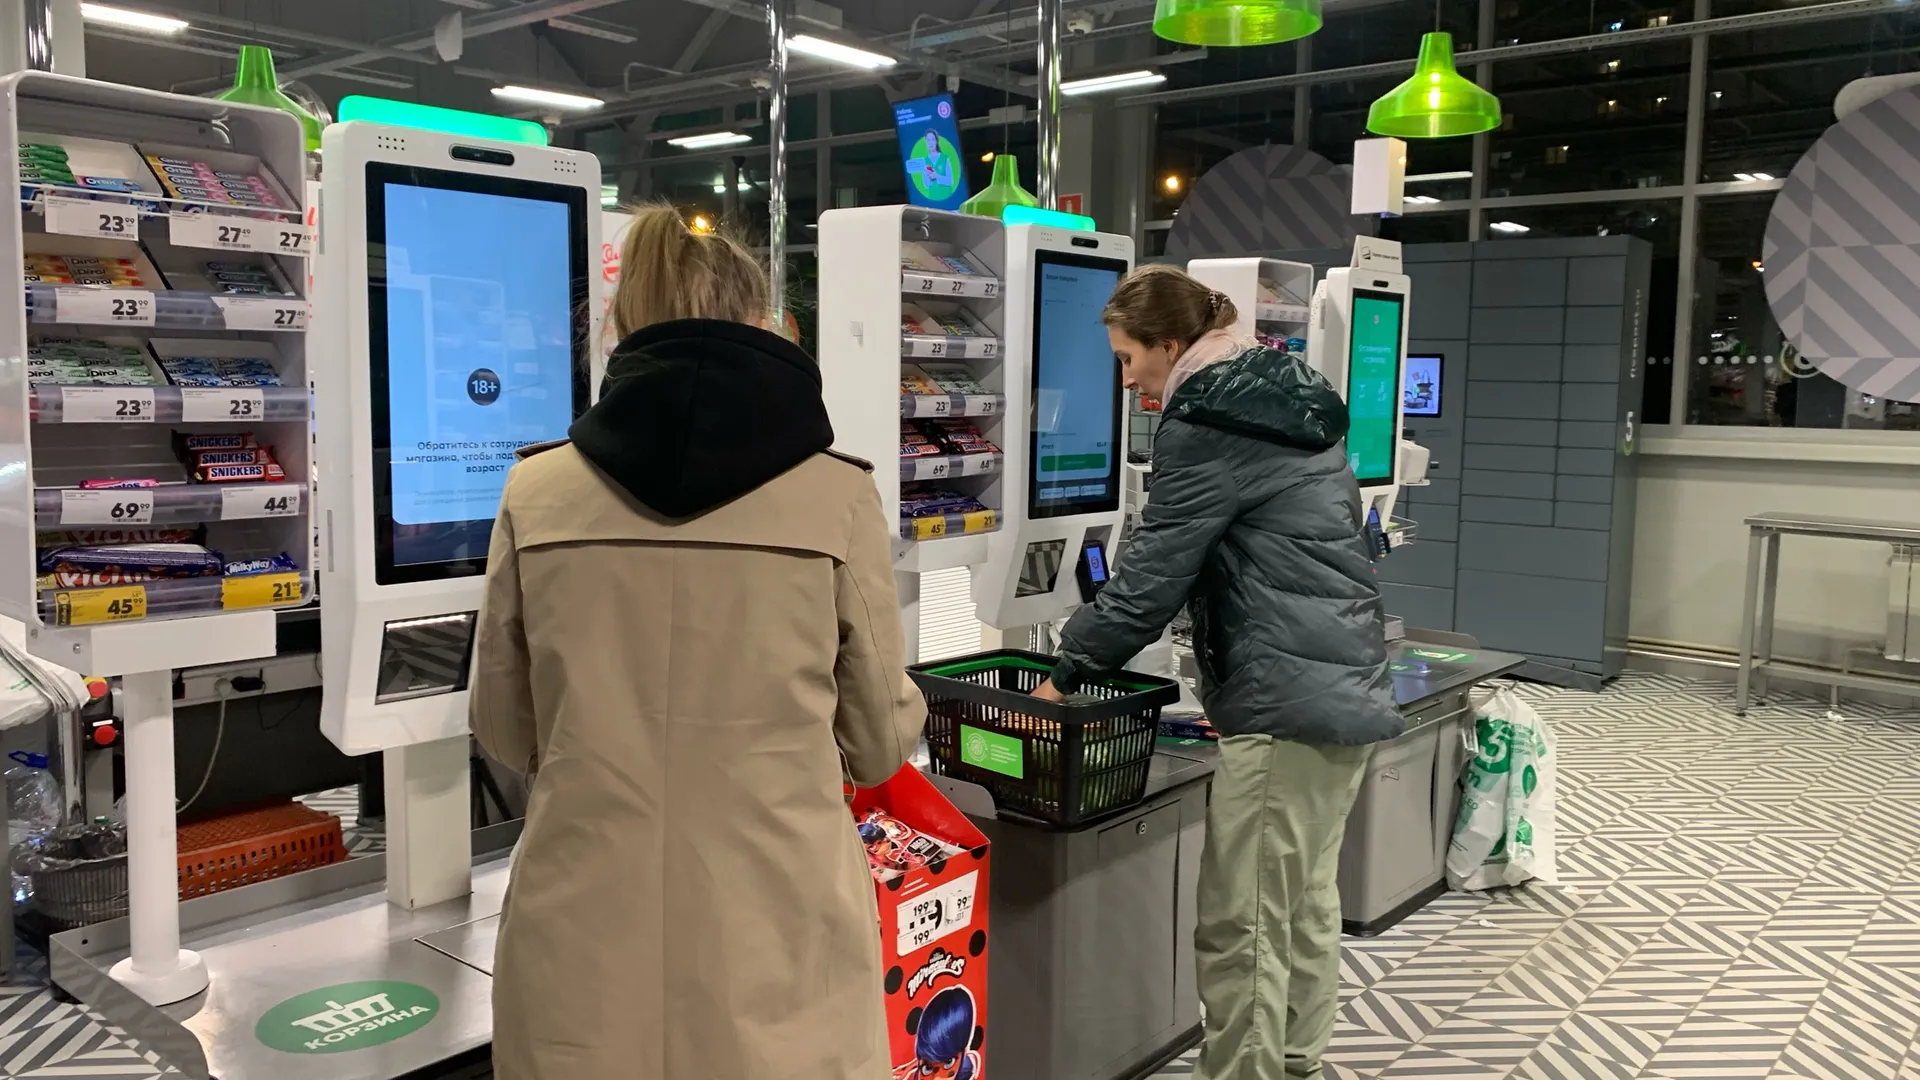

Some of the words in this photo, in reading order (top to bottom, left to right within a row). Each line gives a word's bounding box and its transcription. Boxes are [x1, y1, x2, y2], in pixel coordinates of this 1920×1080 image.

[164, 165, 194, 175] Orbit
[170, 176, 200, 186] Orbit
[177, 186, 208, 196] Orbit
[99, 214, 125, 232] 23
[218, 226, 241, 243] 27
[280, 231, 302, 248] 27
[922, 279, 933, 290] 23
[951, 281, 962, 291] 27
[984, 283, 994, 293] 27
[112, 299, 138, 316] 23
[274, 309, 297, 325] 27
[931, 343, 942, 353] 23
[983, 344, 993, 353] 27
[91, 369, 118, 377] Dirol
[471, 379, 498, 394] 18+
[116, 400, 141, 416] 23
[229, 399, 252, 415] 23
[936, 401, 946, 411] 23
[982, 402, 992, 411] 23
[188, 436, 241, 448] SNICKERS
[417, 440, 479, 451] Обратитесь
[202, 452, 253, 464] SNICKERS
[406, 454, 460, 463] магазина,
[462, 452, 493, 461] чтобы
[211, 466, 262, 478] SNICKERS
[466, 464, 505, 473] возраст
[933, 465, 944, 475] 69
[111, 502, 139, 518] 69
[264, 497, 287, 512] 44
[984, 516, 992, 526] 21
[931, 525, 940, 534] 45
[273, 582, 291, 598] 21
[107, 598, 133, 615] 45
[913, 901, 930, 916] 199
[957, 896, 968, 909] 99
[913, 930, 930, 945] 199
[303, 1004, 431, 1050] КОРЗИНА
